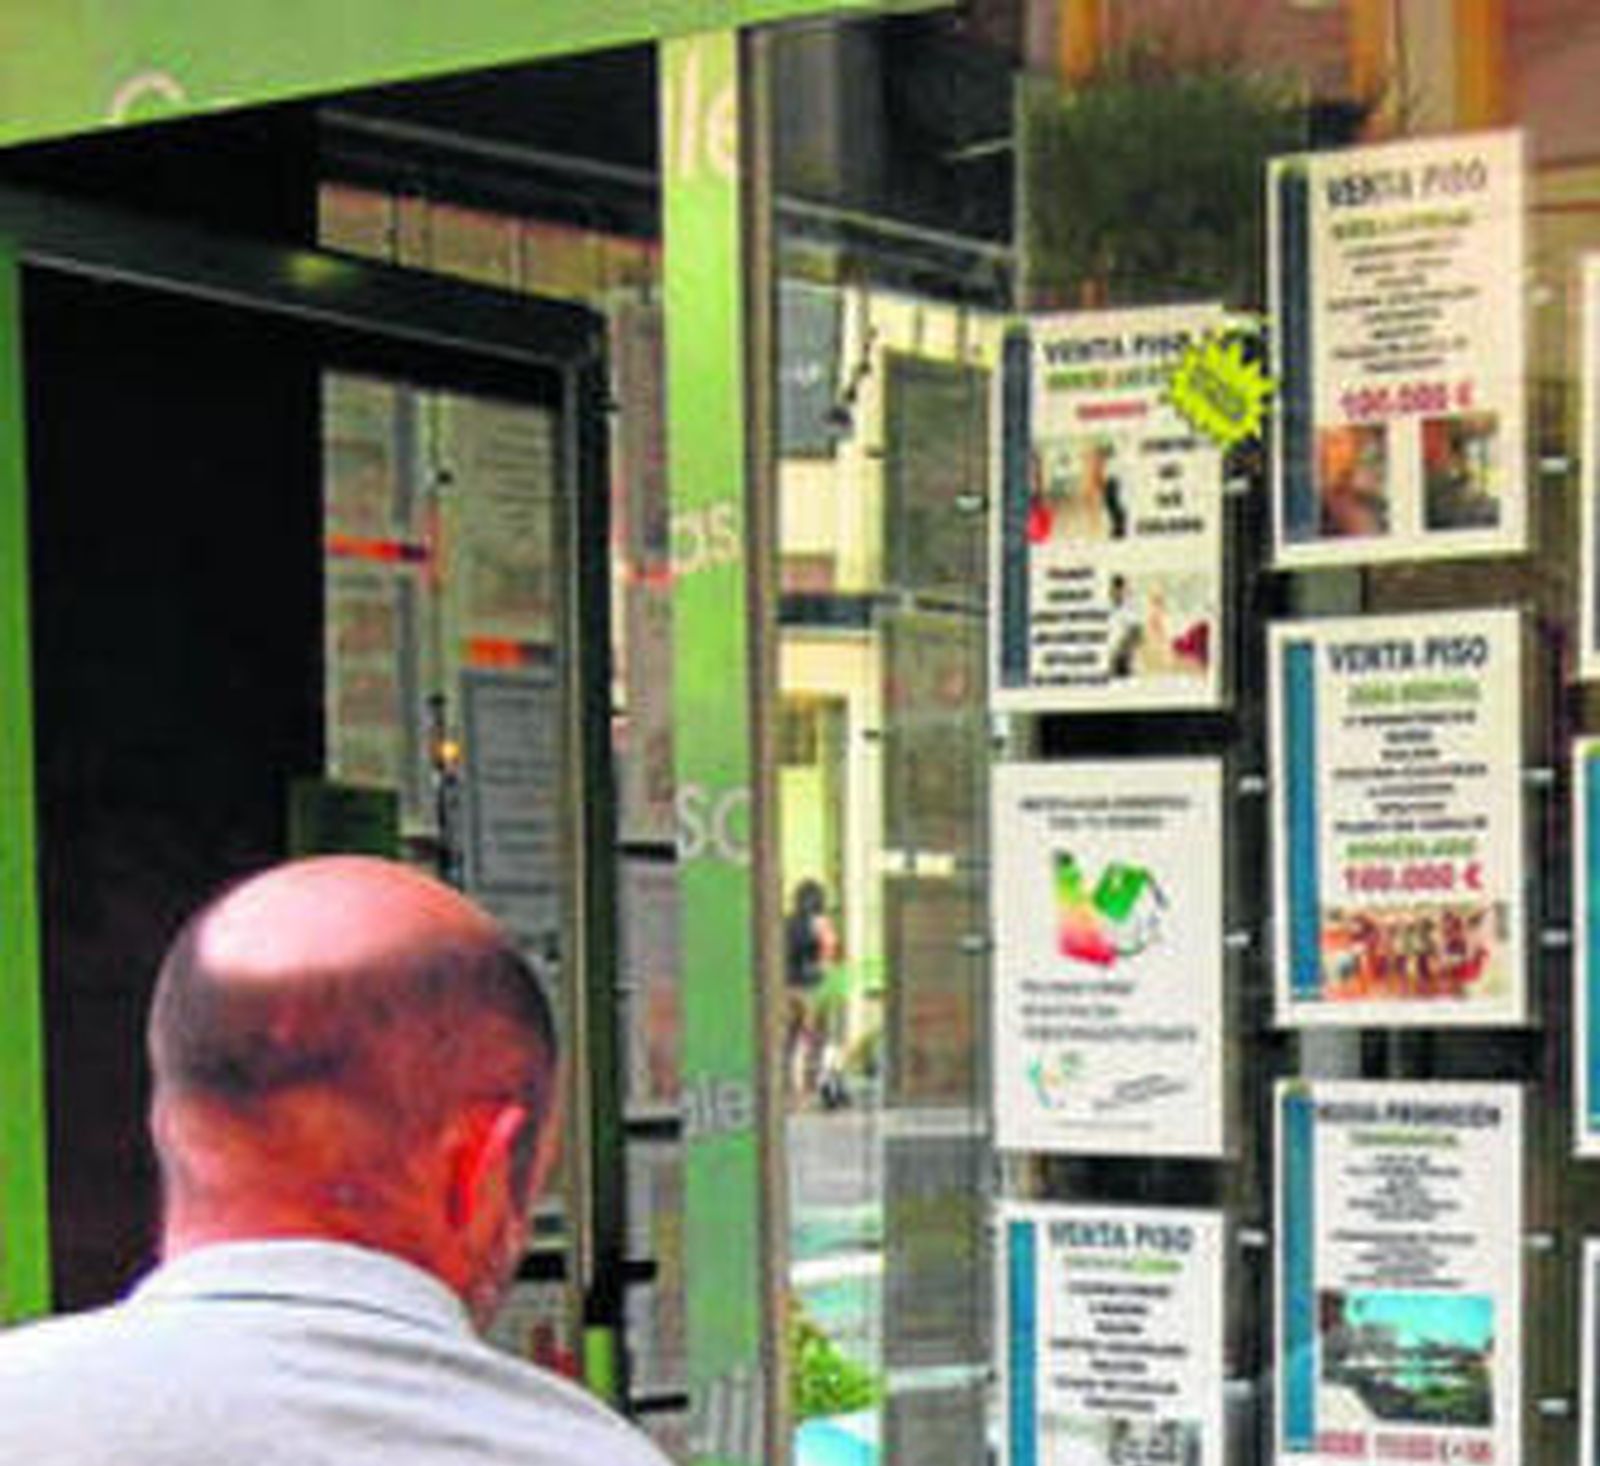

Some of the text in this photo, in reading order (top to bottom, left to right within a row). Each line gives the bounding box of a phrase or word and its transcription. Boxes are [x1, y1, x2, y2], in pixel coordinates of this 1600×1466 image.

[1327, 156, 1489, 207] VENTA PISO
[1045, 335, 1124, 362] VENTA
[1327, 633, 1491, 674] VENTA PISO
[1464, 863, 1483, 890] €
[1049, 1219, 1194, 1253] VENTA PISO
